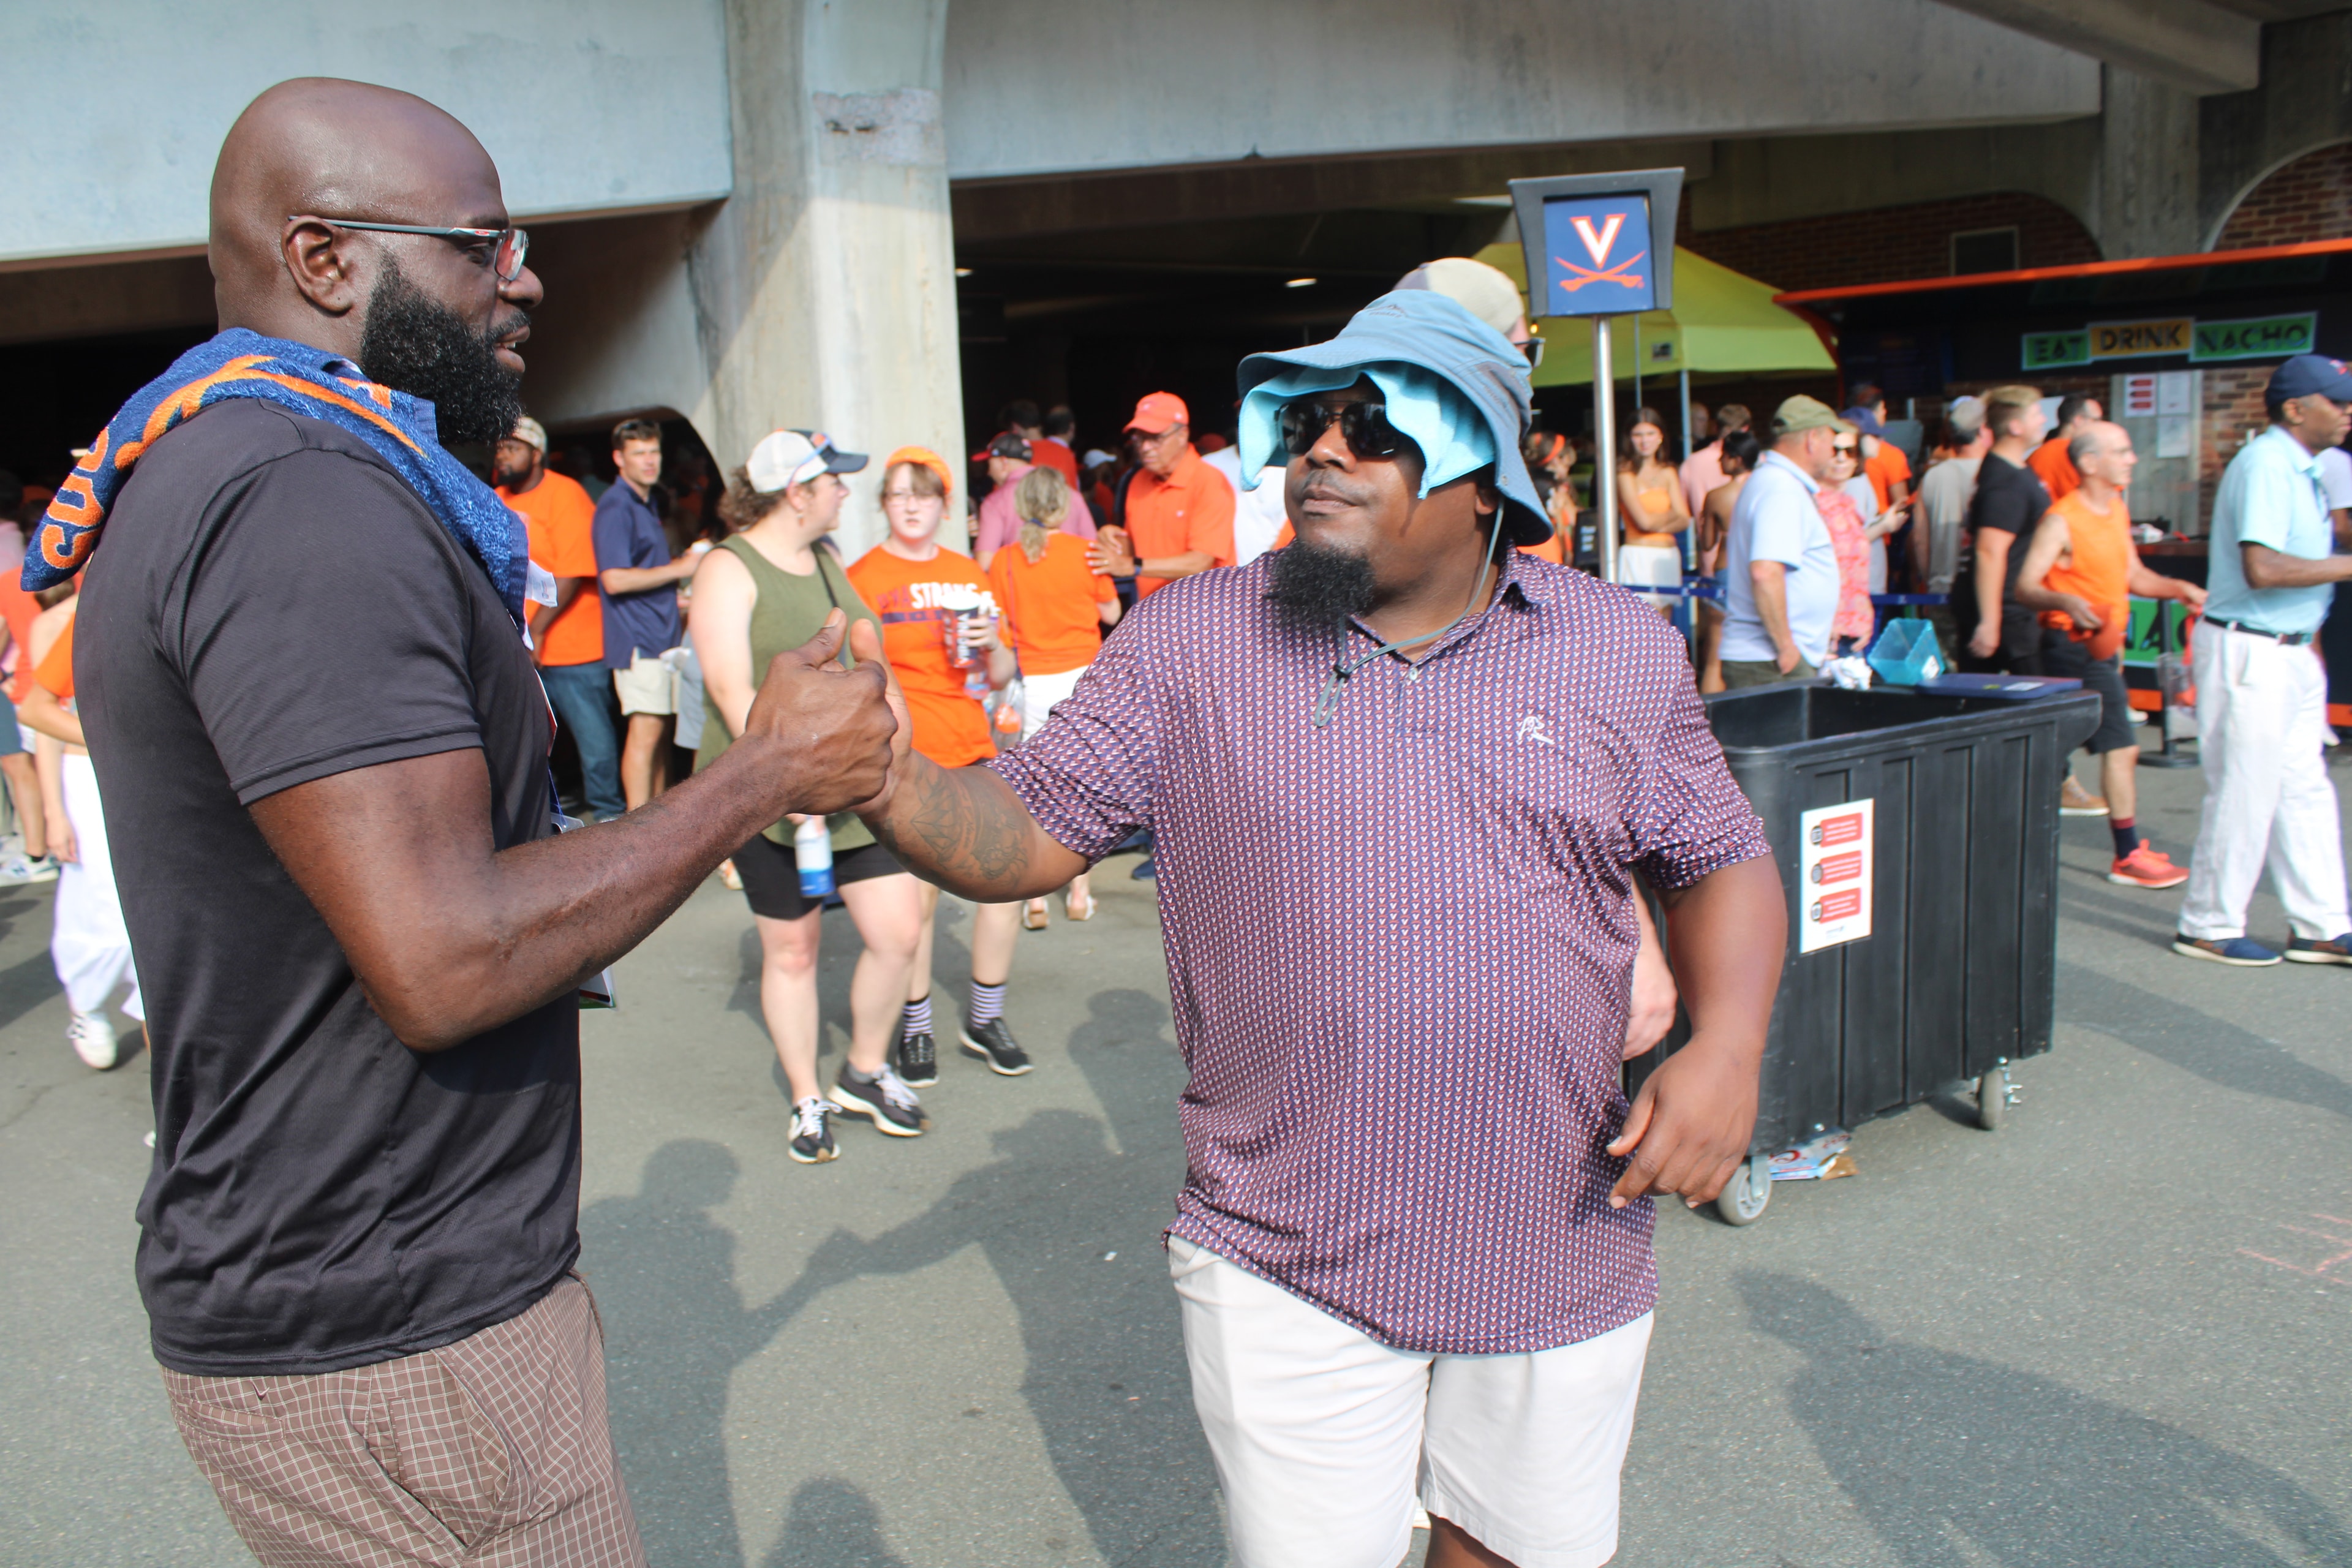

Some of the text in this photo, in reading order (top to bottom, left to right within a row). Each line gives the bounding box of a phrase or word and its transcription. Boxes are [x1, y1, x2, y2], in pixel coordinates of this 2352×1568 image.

[1569, 213, 1627, 270] V
[2034, 323, 2307, 362] EAT DRINK NACHO
